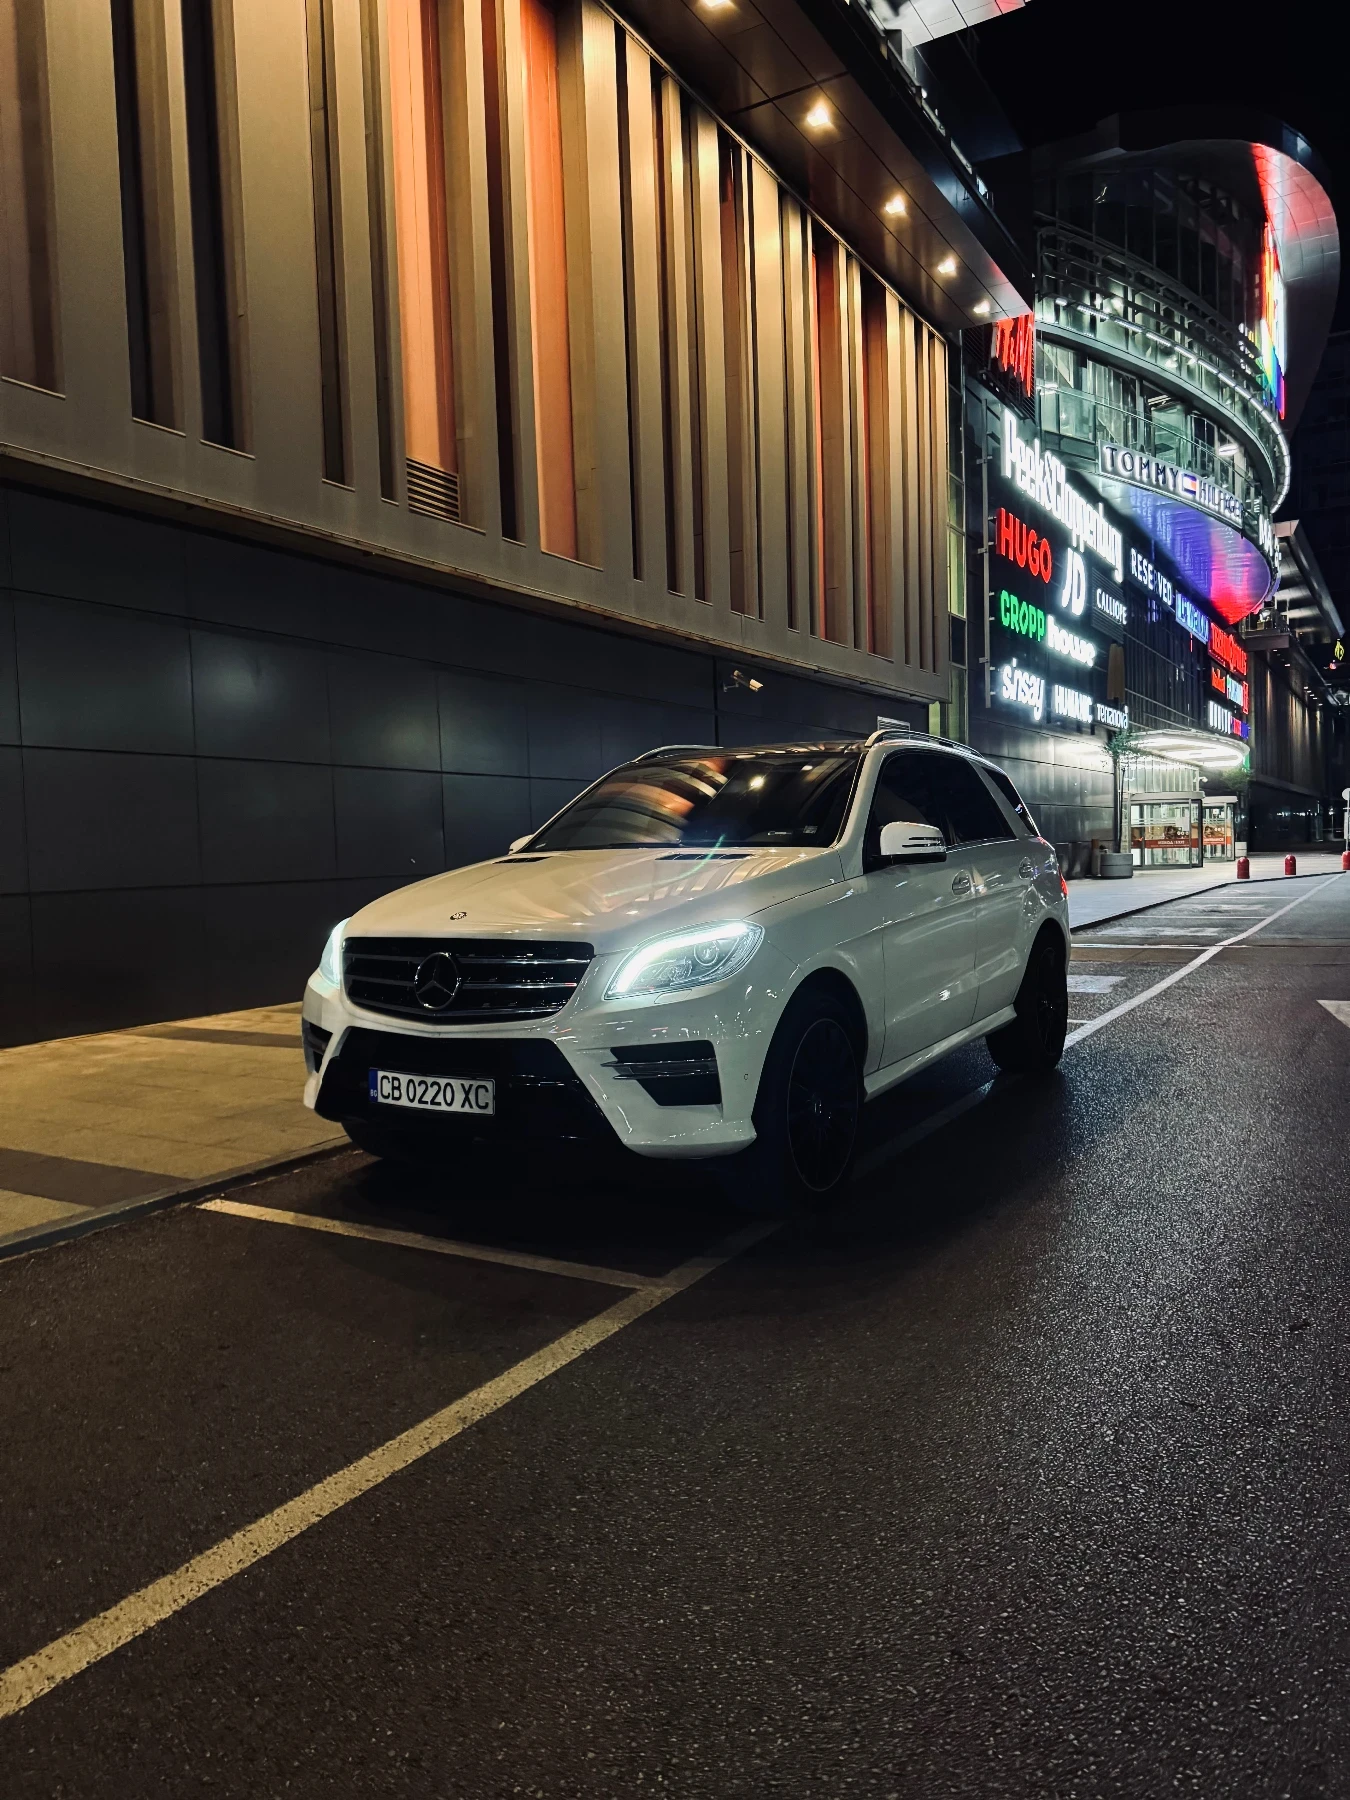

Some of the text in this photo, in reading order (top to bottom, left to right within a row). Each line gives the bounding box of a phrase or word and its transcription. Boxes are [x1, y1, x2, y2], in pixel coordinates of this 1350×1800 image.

[1105, 446, 1179, 488] TOMMY
[998, 508, 1052, 583] HUGO
[1062, 547, 1086, 615] JD
[1131, 547, 1172, 606] RESERVED
[1000, 589, 1045, 641] CROPP
[1096, 588, 1128, 625] CALLIOPE
[1002, 657, 1045, 721] sinsay
[370, 1089, 378, 1098] BG
[380, 1075, 489, 1109] CB 0220 XC
